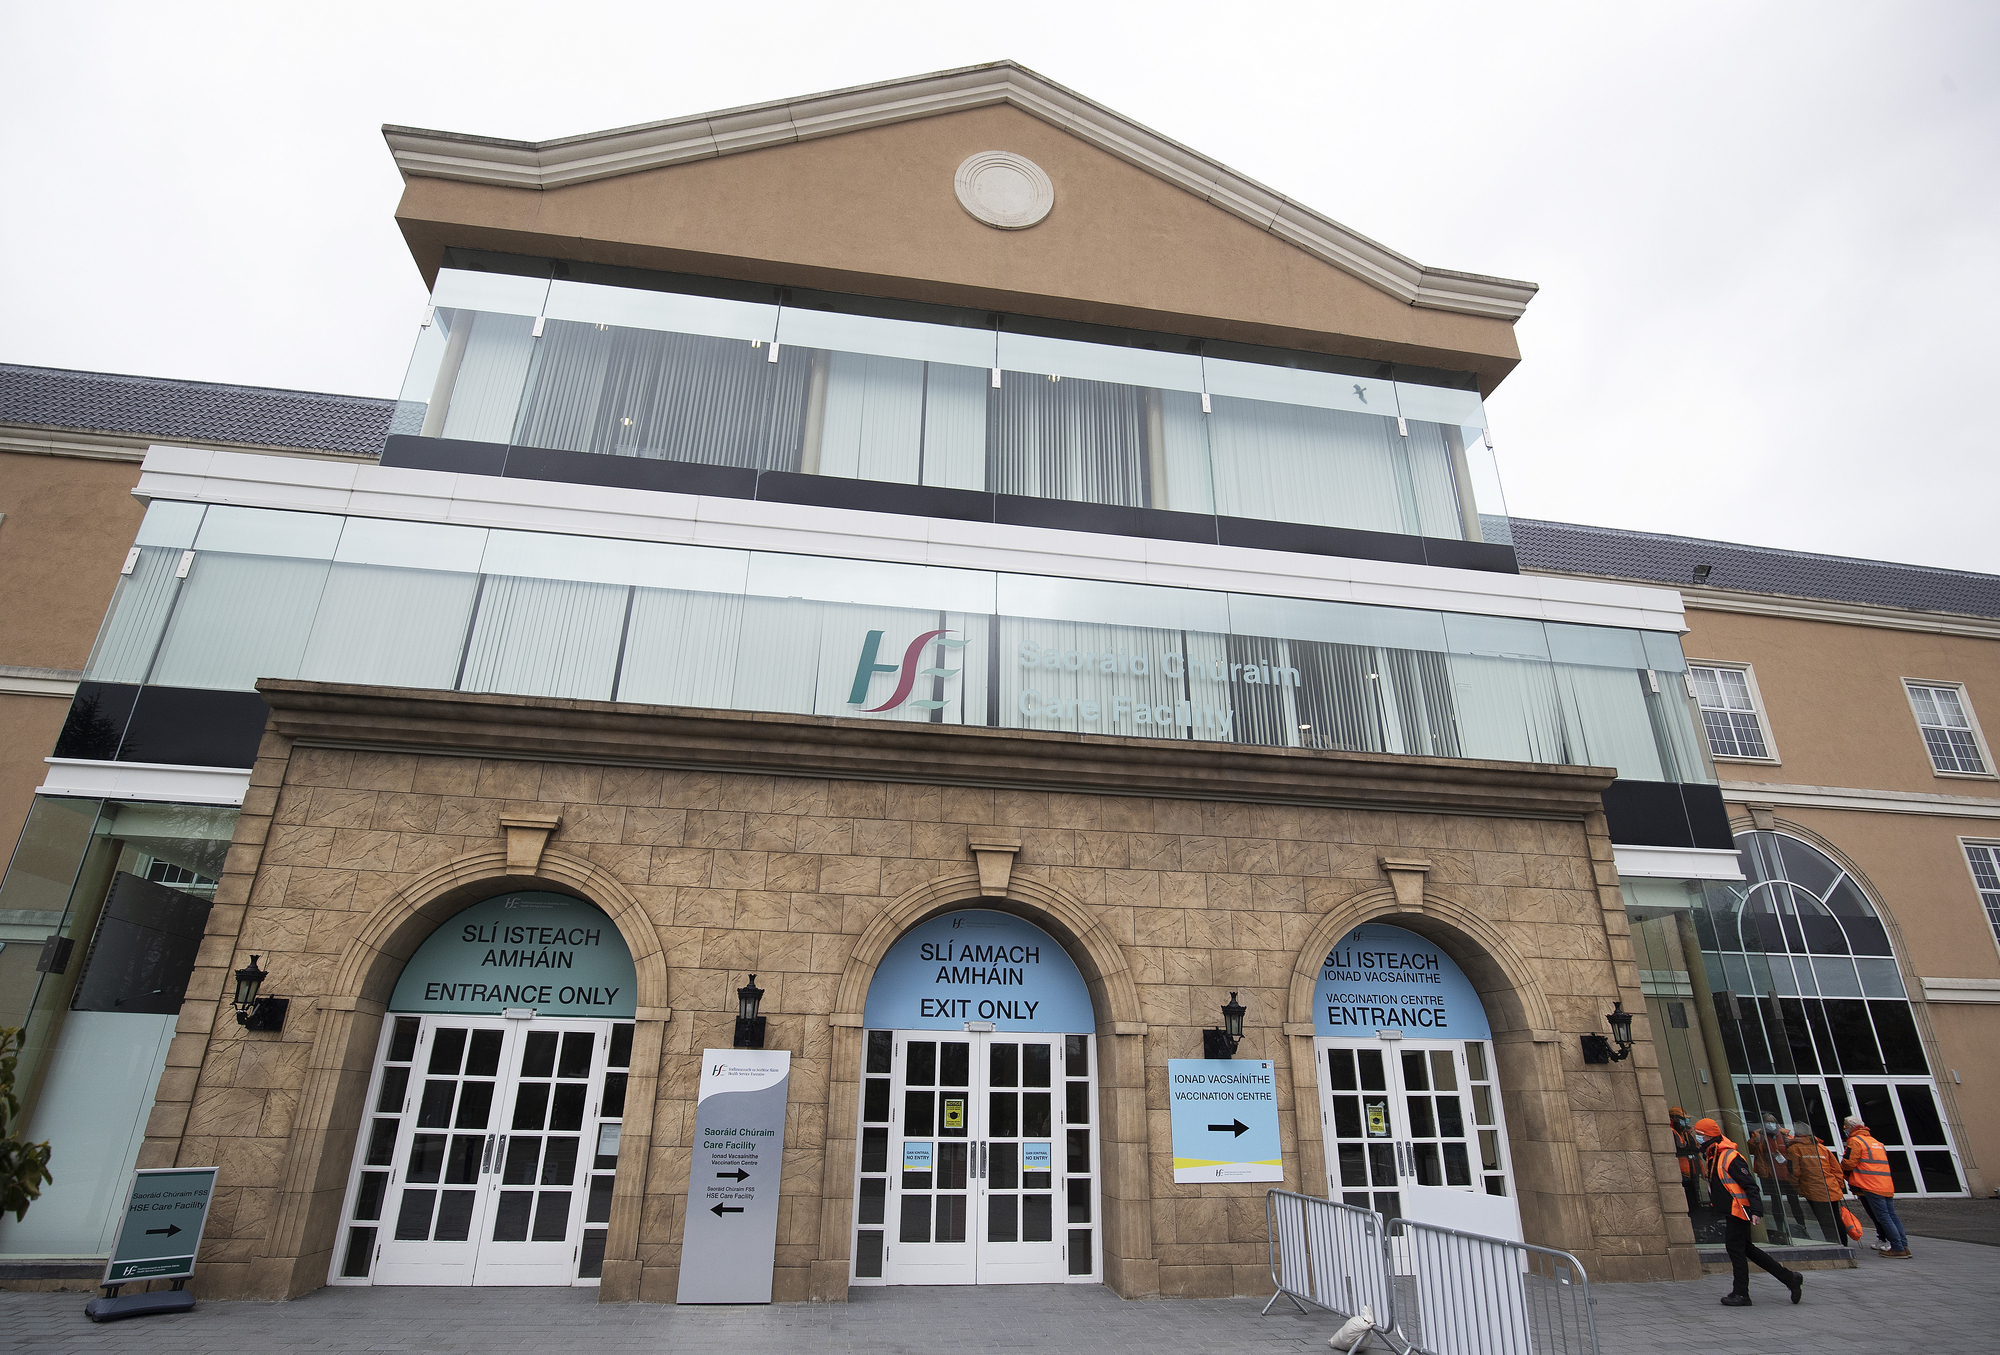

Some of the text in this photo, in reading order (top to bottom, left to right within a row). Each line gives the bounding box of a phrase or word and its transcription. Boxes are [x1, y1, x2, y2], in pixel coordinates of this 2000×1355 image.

[1018, 640, 1301, 687] Saoráid Chúraim
[1018, 689, 1234, 736] Care Facility
[461, 921, 601, 947] SLÍ ISTEACH
[481, 946, 573, 969] AMHÁIN
[920, 939, 1040, 964] SLÍ AMACH
[1324, 947, 1439, 970] SLÍ ISTEACH
[935, 962, 1023, 985] AMHÁIN
[1325, 970, 1441, 984] IONAD VACSAÍNITHE
[424, 982, 620, 1005] ENTRANCE ONLY
[1326, 993, 1444, 1006] VACCINATION CENTRE
[920, 998, 1039, 1020] EXIT ONLY
[1328, 1006, 1448, 1028] ENTRANCE
[1174, 1074, 1205, 1084] IONAD
[1175, 1091, 1272, 1101] VACCINATION CENTRE
[704, 1128, 775, 1137] Saoráid Chúraim
[703, 1141, 756, 1151] Care Facility
[163, 1190, 192, 1198] Chúraim
[130, 1201, 206, 1212] HSE Care Facility
